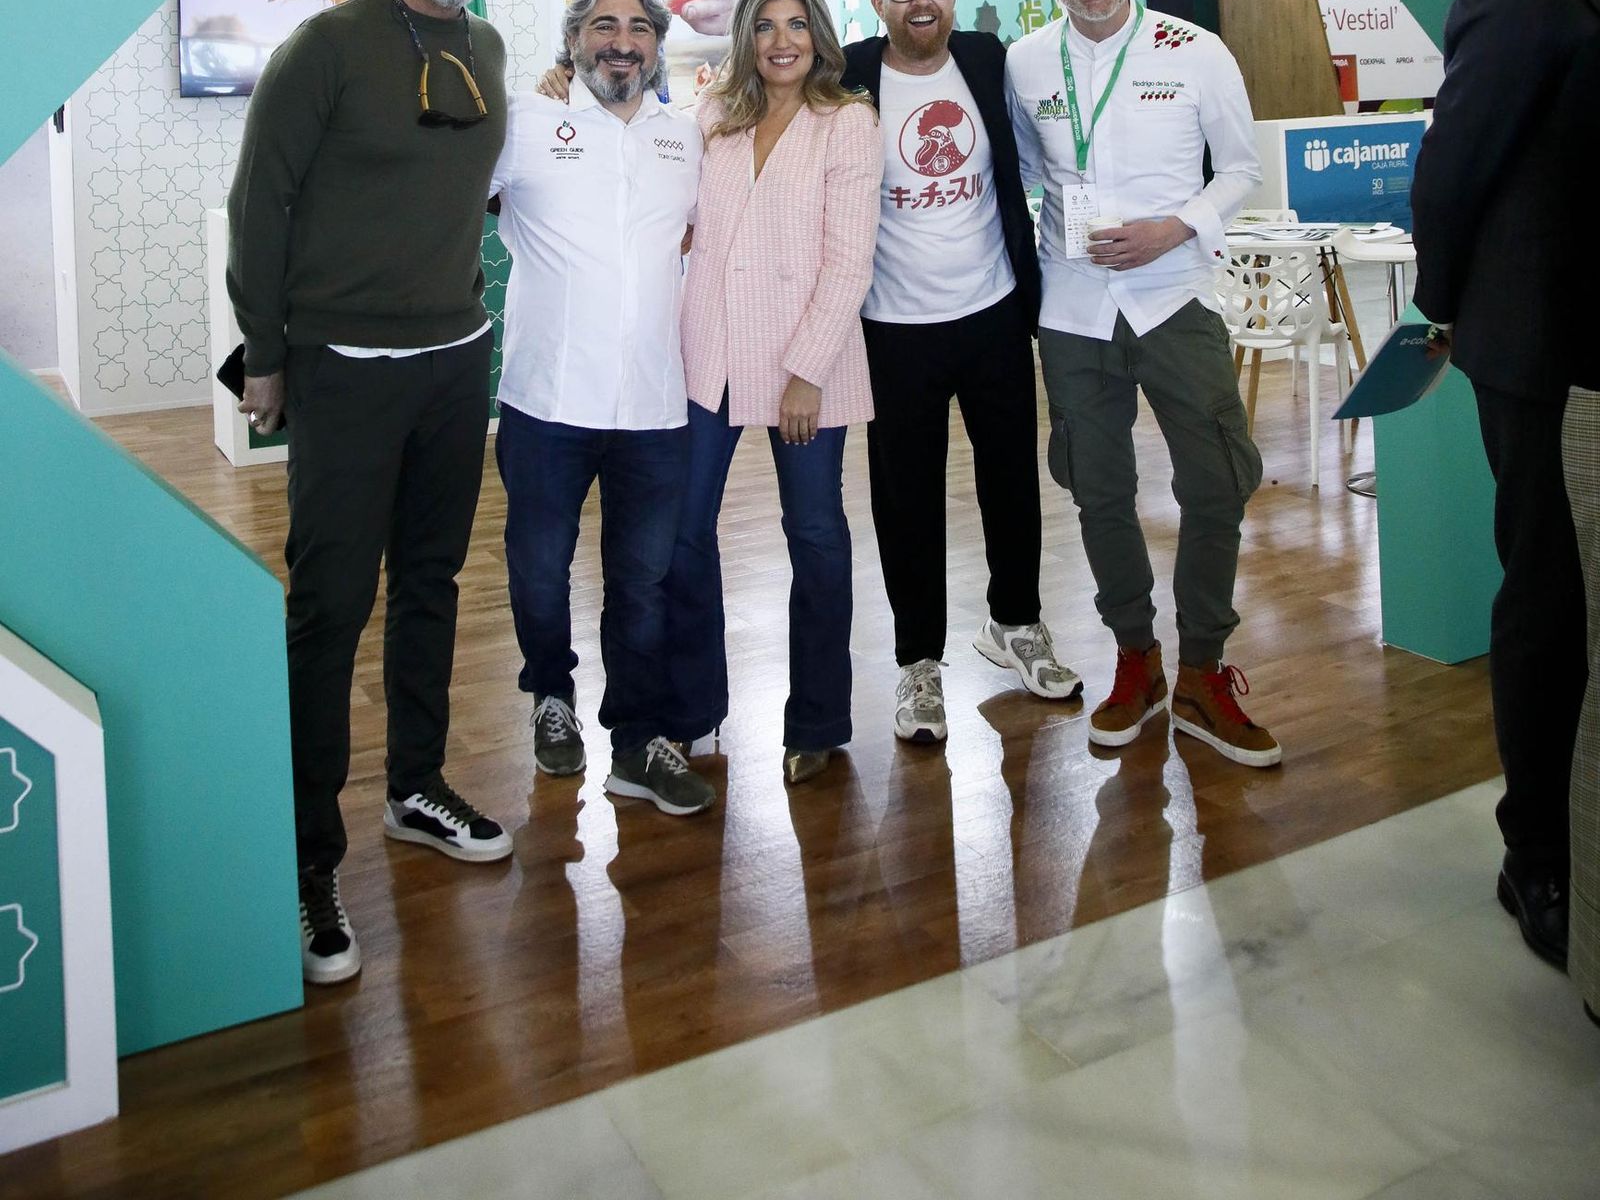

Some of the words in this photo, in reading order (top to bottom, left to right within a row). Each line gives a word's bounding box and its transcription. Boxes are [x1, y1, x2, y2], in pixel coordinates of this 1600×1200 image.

[1132, 80, 1155, 88] Rodrigo
[1037, 106, 1067, 116] SMART
[1333, 139, 1410, 169] cajamar
[1372, 161, 1388, 170] CAJA
[1388, 161, 1409, 169] RURAL
[1372, 178, 1384, 190] 50
